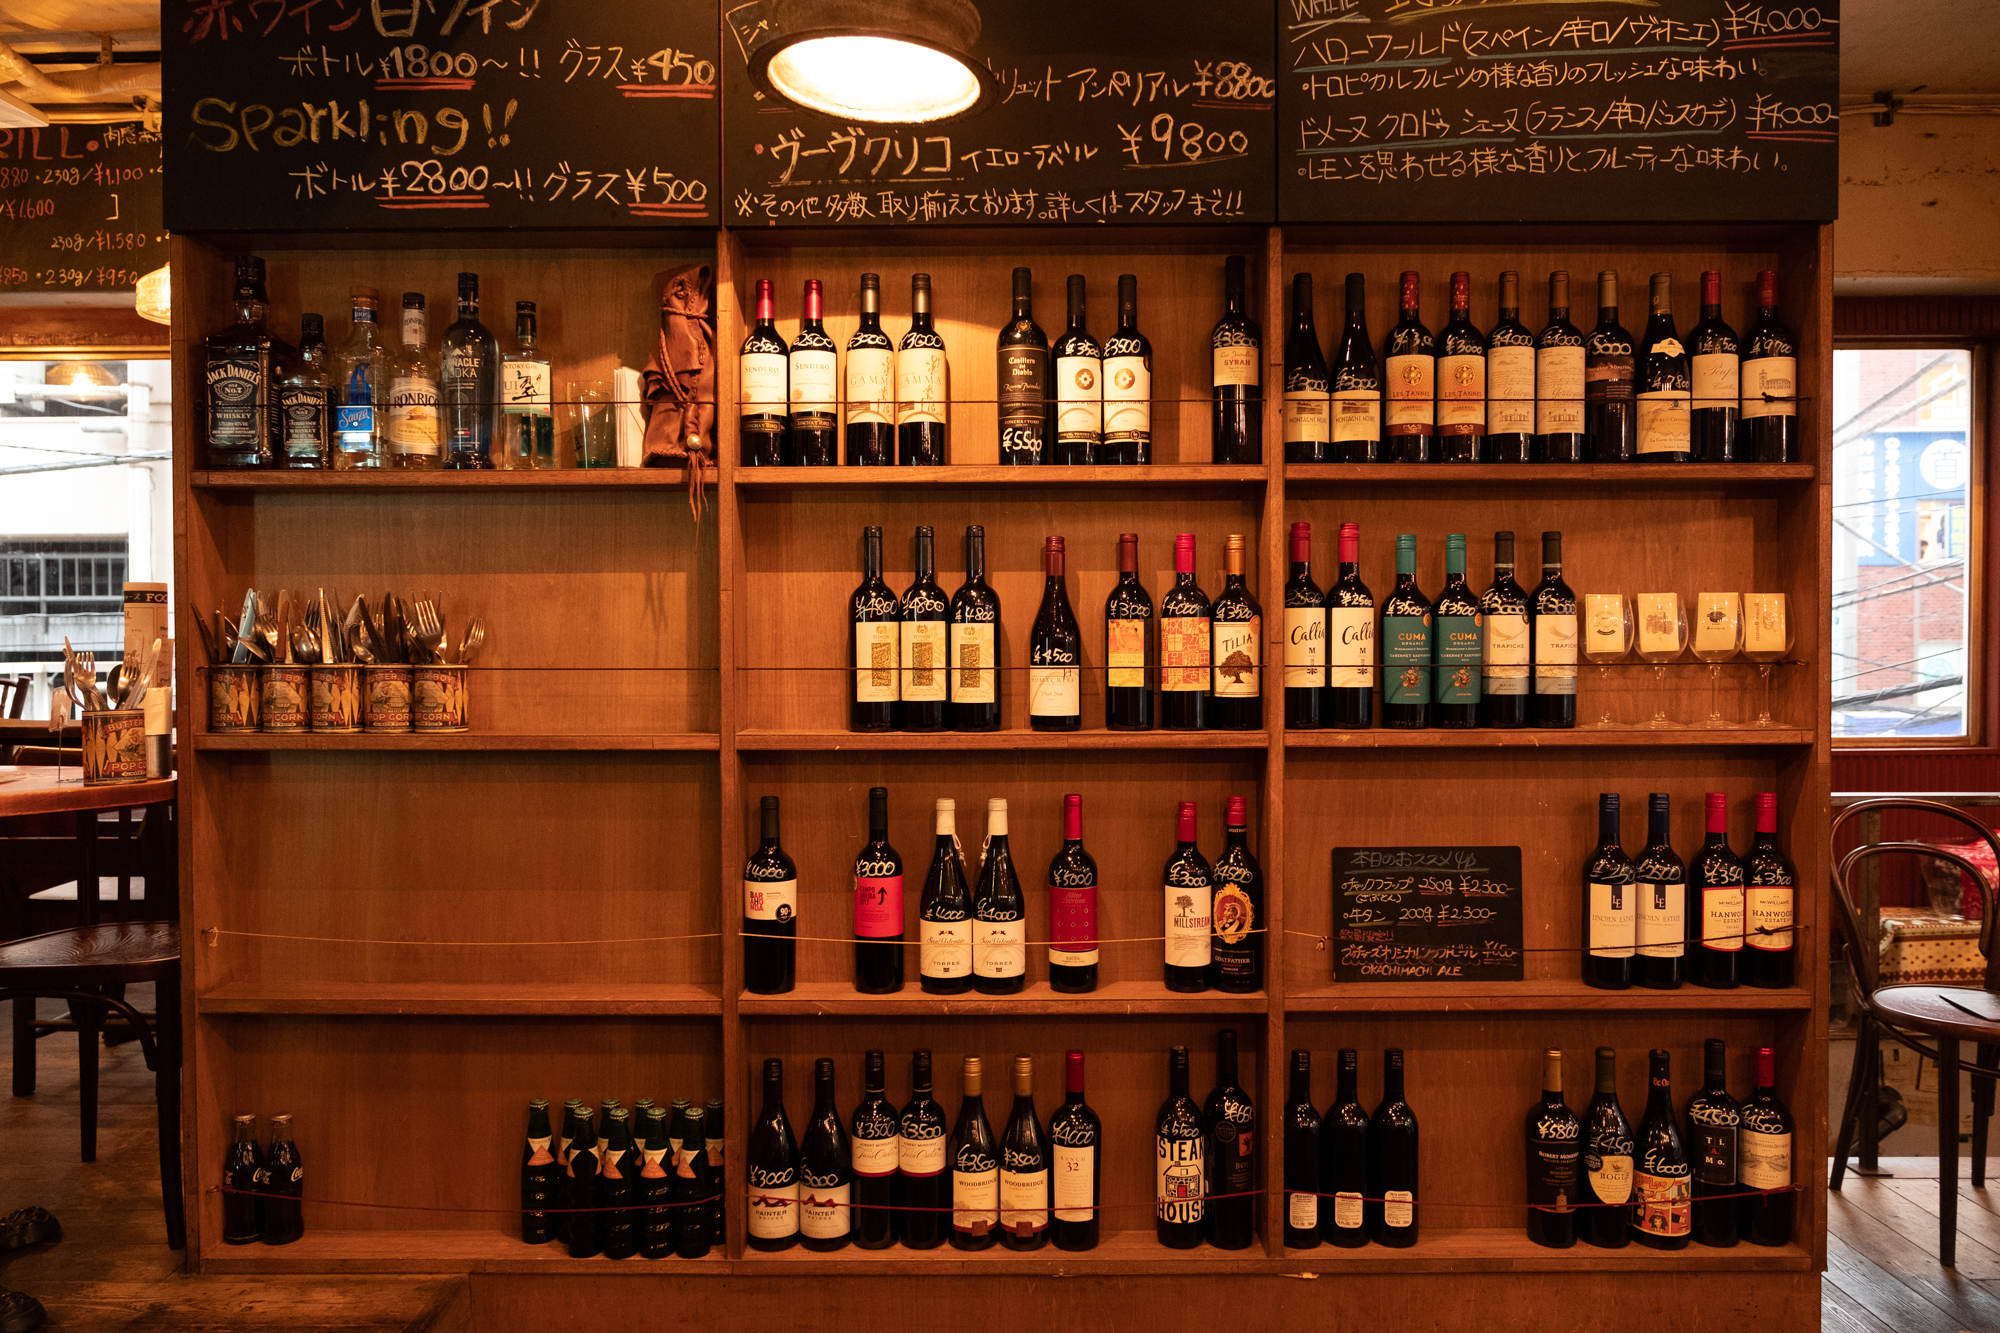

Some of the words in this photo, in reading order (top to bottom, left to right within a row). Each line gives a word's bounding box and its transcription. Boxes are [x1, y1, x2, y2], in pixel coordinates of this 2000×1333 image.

[1117, 113, 1249, 164] ¥9800
[1446, 334, 1482, 355] ¥3000
[206, 368, 228, 385] JACK
[227, 364, 262, 386] DANIEL'S
[744, 365, 780, 374] SENDERO
[795, 362, 830, 371] SENDERO
[339, 408, 371, 429] Sauza
[1002, 427, 1043, 452] ¥5500
[1341, 590, 1373, 607] ¥2500
[1386, 597, 1423, 617] ¥3500
[1439, 598, 1476, 616] ¥3500
[955, 600, 995, 621] ¥4800
[1110, 600, 1150, 619] ¥3000
[1222, 633, 1254, 652] TILIA
[1398, 633, 1426, 641] CUMA
[1450, 633, 1478, 641] CUMA
[1033, 645, 1073, 664] ¥4500
[285, 674, 307, 683] BOY
[319, 674, 341, 683] BOY
[433, 673, 455, 683] BOY
[107, 719, 144, 732] BUTTER
[111, 763, 133, 771] POP
[856, 860, 896, 878] ¥3000
[1053, 868, 1093, 887] ¥5000
[1169, 859, 1207, 887] ¥3000
[1751, 866, 1792, 885] ¥3500
[1418, 876, 1456, 894] 250g
[925, 901, 966, 921] ¥4000
[977, 897, 1017, 921] ¥4000
[1398, 906, 1434, 922] 200g
[1361, 965, 1433, 977] OKACHIMACHI
[1436, 966, 1463, 977] ALE
[856, 1120, 896, 1138] ¥3500
[901, 1114, 942, 1140] ¥3500
[1538, 1121, 1580, 1140] ¥5800
[956, 1144, 996, 1171] ¥3500
[1004, 1147, 1041, 1166] ¥3500
[1538, 1150, 1560, 1159] ROBERT
[1644, 1148, 1688, 1174] ¥6000
[1705, 1156, 1714, 1164] M
[750, 1165, 795, 1187] ¥3000
[1066, 1162, 1080, 1172] 32
[959, 1177, 997, 1187] WOODBRIDGE
[1004, 1178, 1044, 1187] WOODBRIDGE
[755, 1209, 788, 1217] PAINTER
